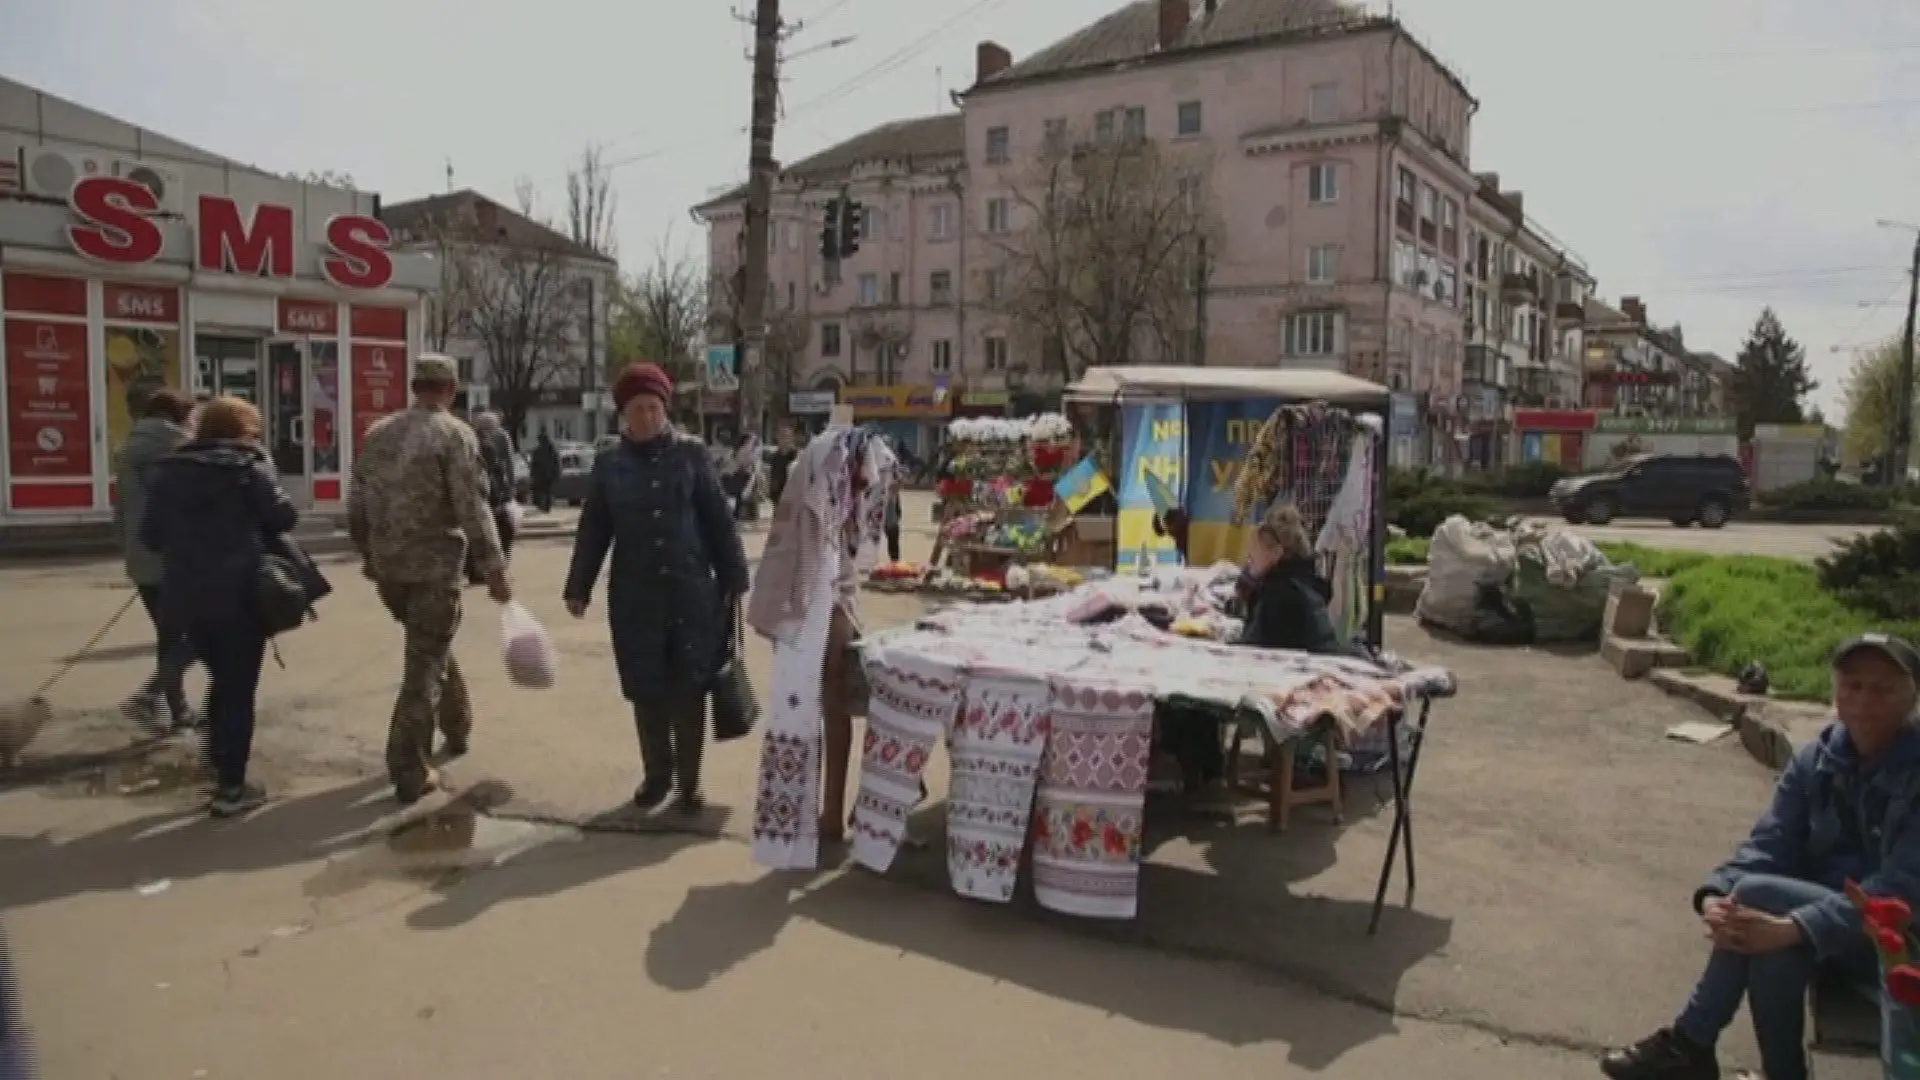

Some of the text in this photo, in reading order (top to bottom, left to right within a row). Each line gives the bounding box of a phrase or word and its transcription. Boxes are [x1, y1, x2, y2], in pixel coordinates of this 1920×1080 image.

[68, 175, 394, 289] SMS
[116, 291, 165, 317] SMS
[286, 308, 328, 330] SMS
[1226, 418, 1263, 444] ПР
